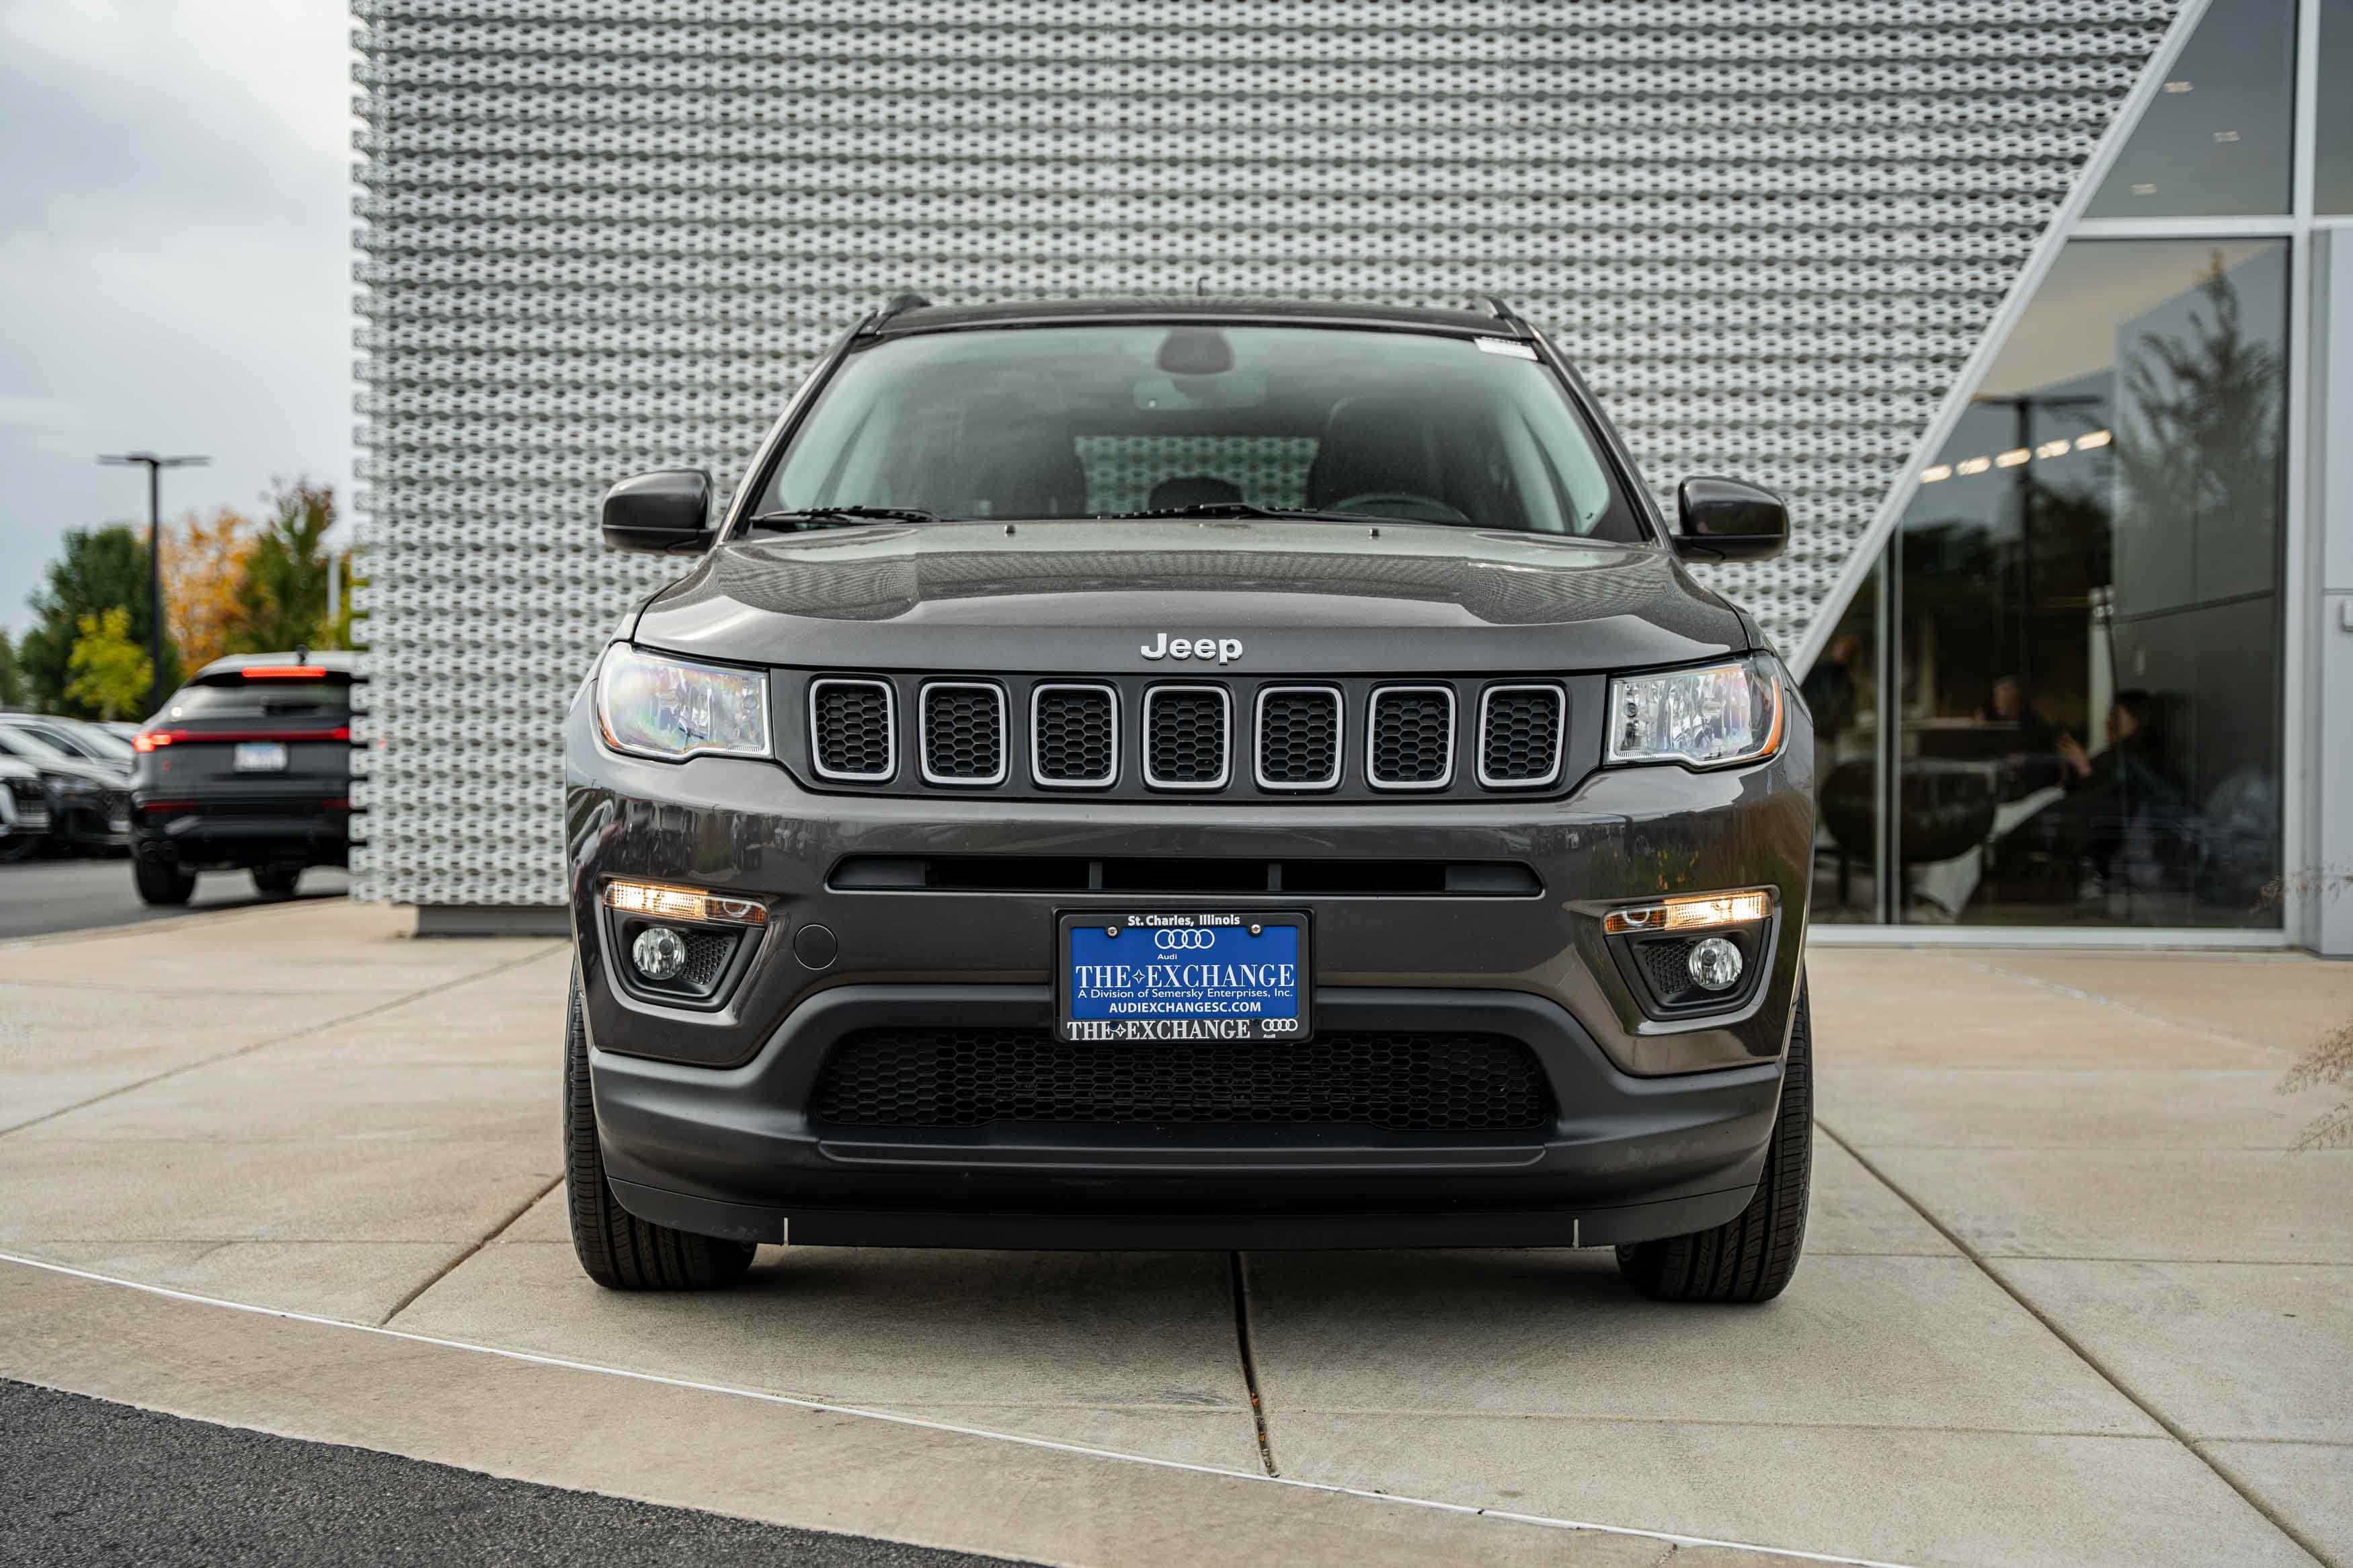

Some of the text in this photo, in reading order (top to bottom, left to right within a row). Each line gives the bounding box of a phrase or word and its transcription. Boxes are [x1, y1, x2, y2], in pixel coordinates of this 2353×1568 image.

[1140, 632, 1243, 666] Jeep
[1127, 914, 1240, 927] St. Charles, Illinois
[1076, 964, 1295, 989] THE EXCHANGE
[1078, 988, 1293, 999] A Division of Semersky Enterprises, Inc.
[1109, 1001, 1262, 1014] AUDIEXCHANGESC.COM
[1067, 1020, 1250, 1040] THE EXCHANGE
